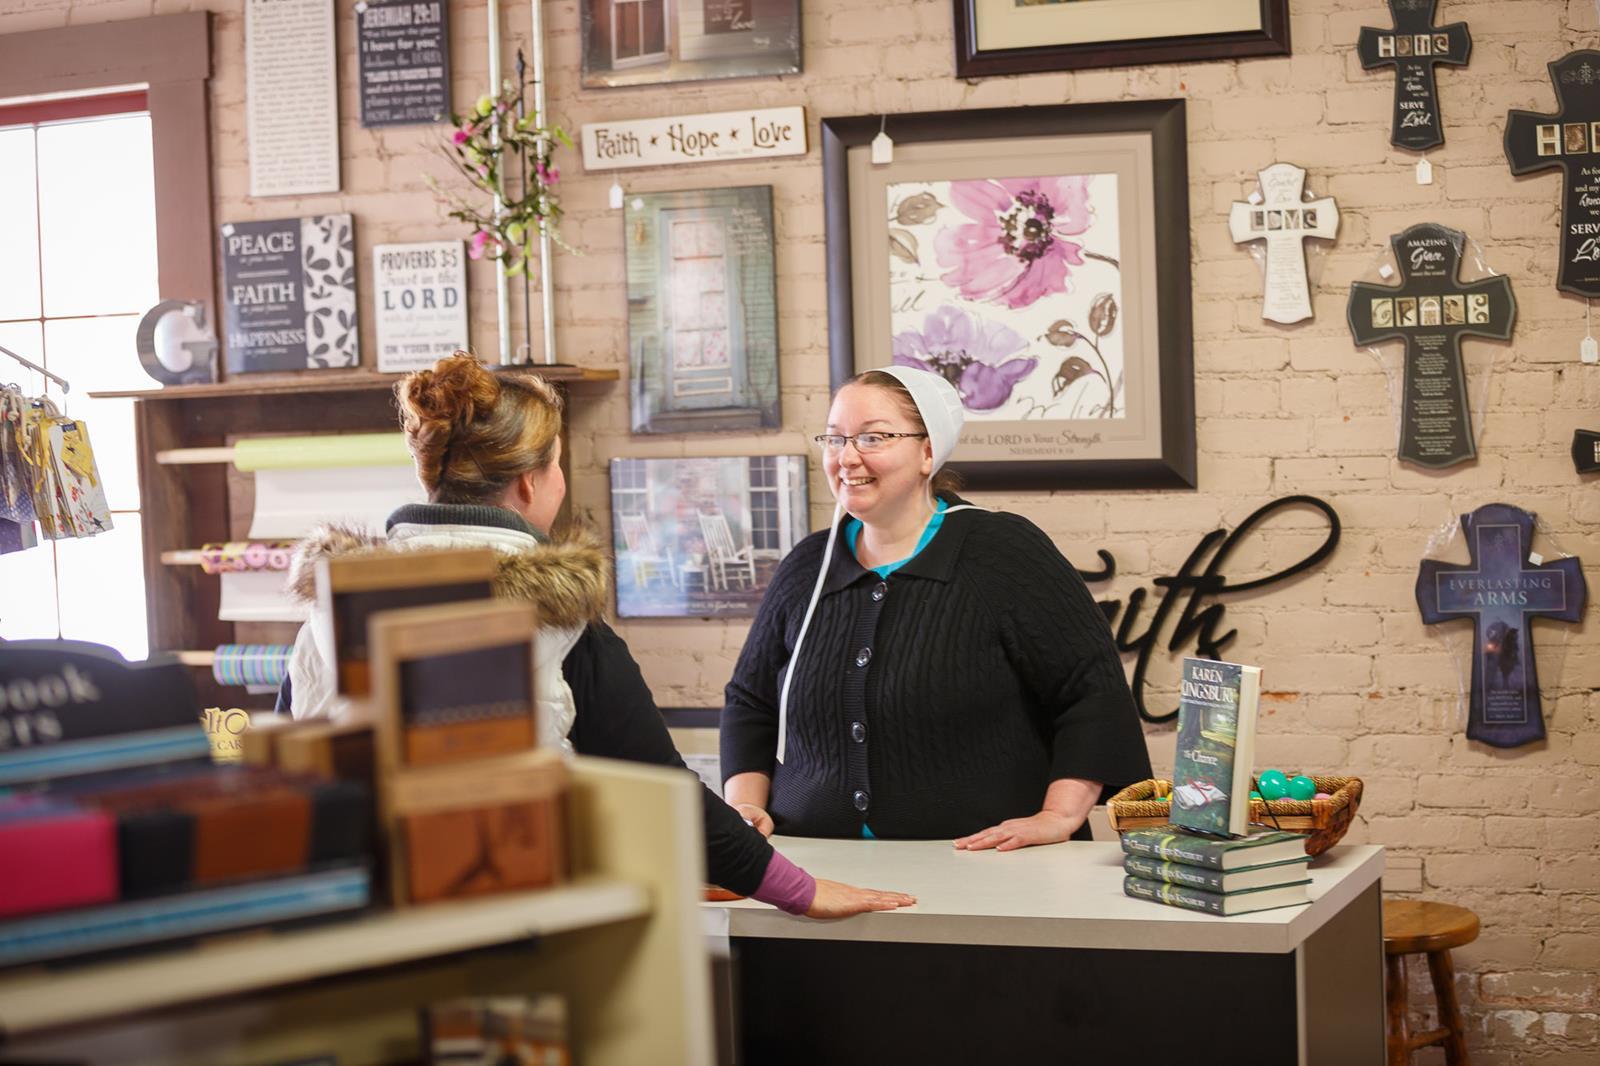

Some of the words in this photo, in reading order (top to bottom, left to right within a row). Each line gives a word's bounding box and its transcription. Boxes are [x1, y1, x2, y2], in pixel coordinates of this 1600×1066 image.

[363, 5, 412, 28] JEREMIAH
[594, 128, 642, 159] Faith
[667, 123, 719, 156] Hope
[751, 116, 792, 150] Love
[1570, 223, 1600, 235] SERV
[228, 231, 295, 256] PEACE
[1408, 239, 1447, 247] AMAZING
[380, 250, 437, 271] PROVERBS
[441, 248, 458, 269] 3:5
[232, 281, 296, 306] FAITH
[383, 287, 458, 311] LORD
[136, 299, 218, 385] G
[229, 328, 306, 348] HAPPINESS
[987, 434, 1023, 445] LORD
[1032, 433, 1054, 443] Your
[1449, 577, 1552, 591] EVERLASTING
[1474, 590, 1528, 606] ARMS
[1192, 666, 1223, 683] KAREN
[1192, 749, 1218, 766] Chance
